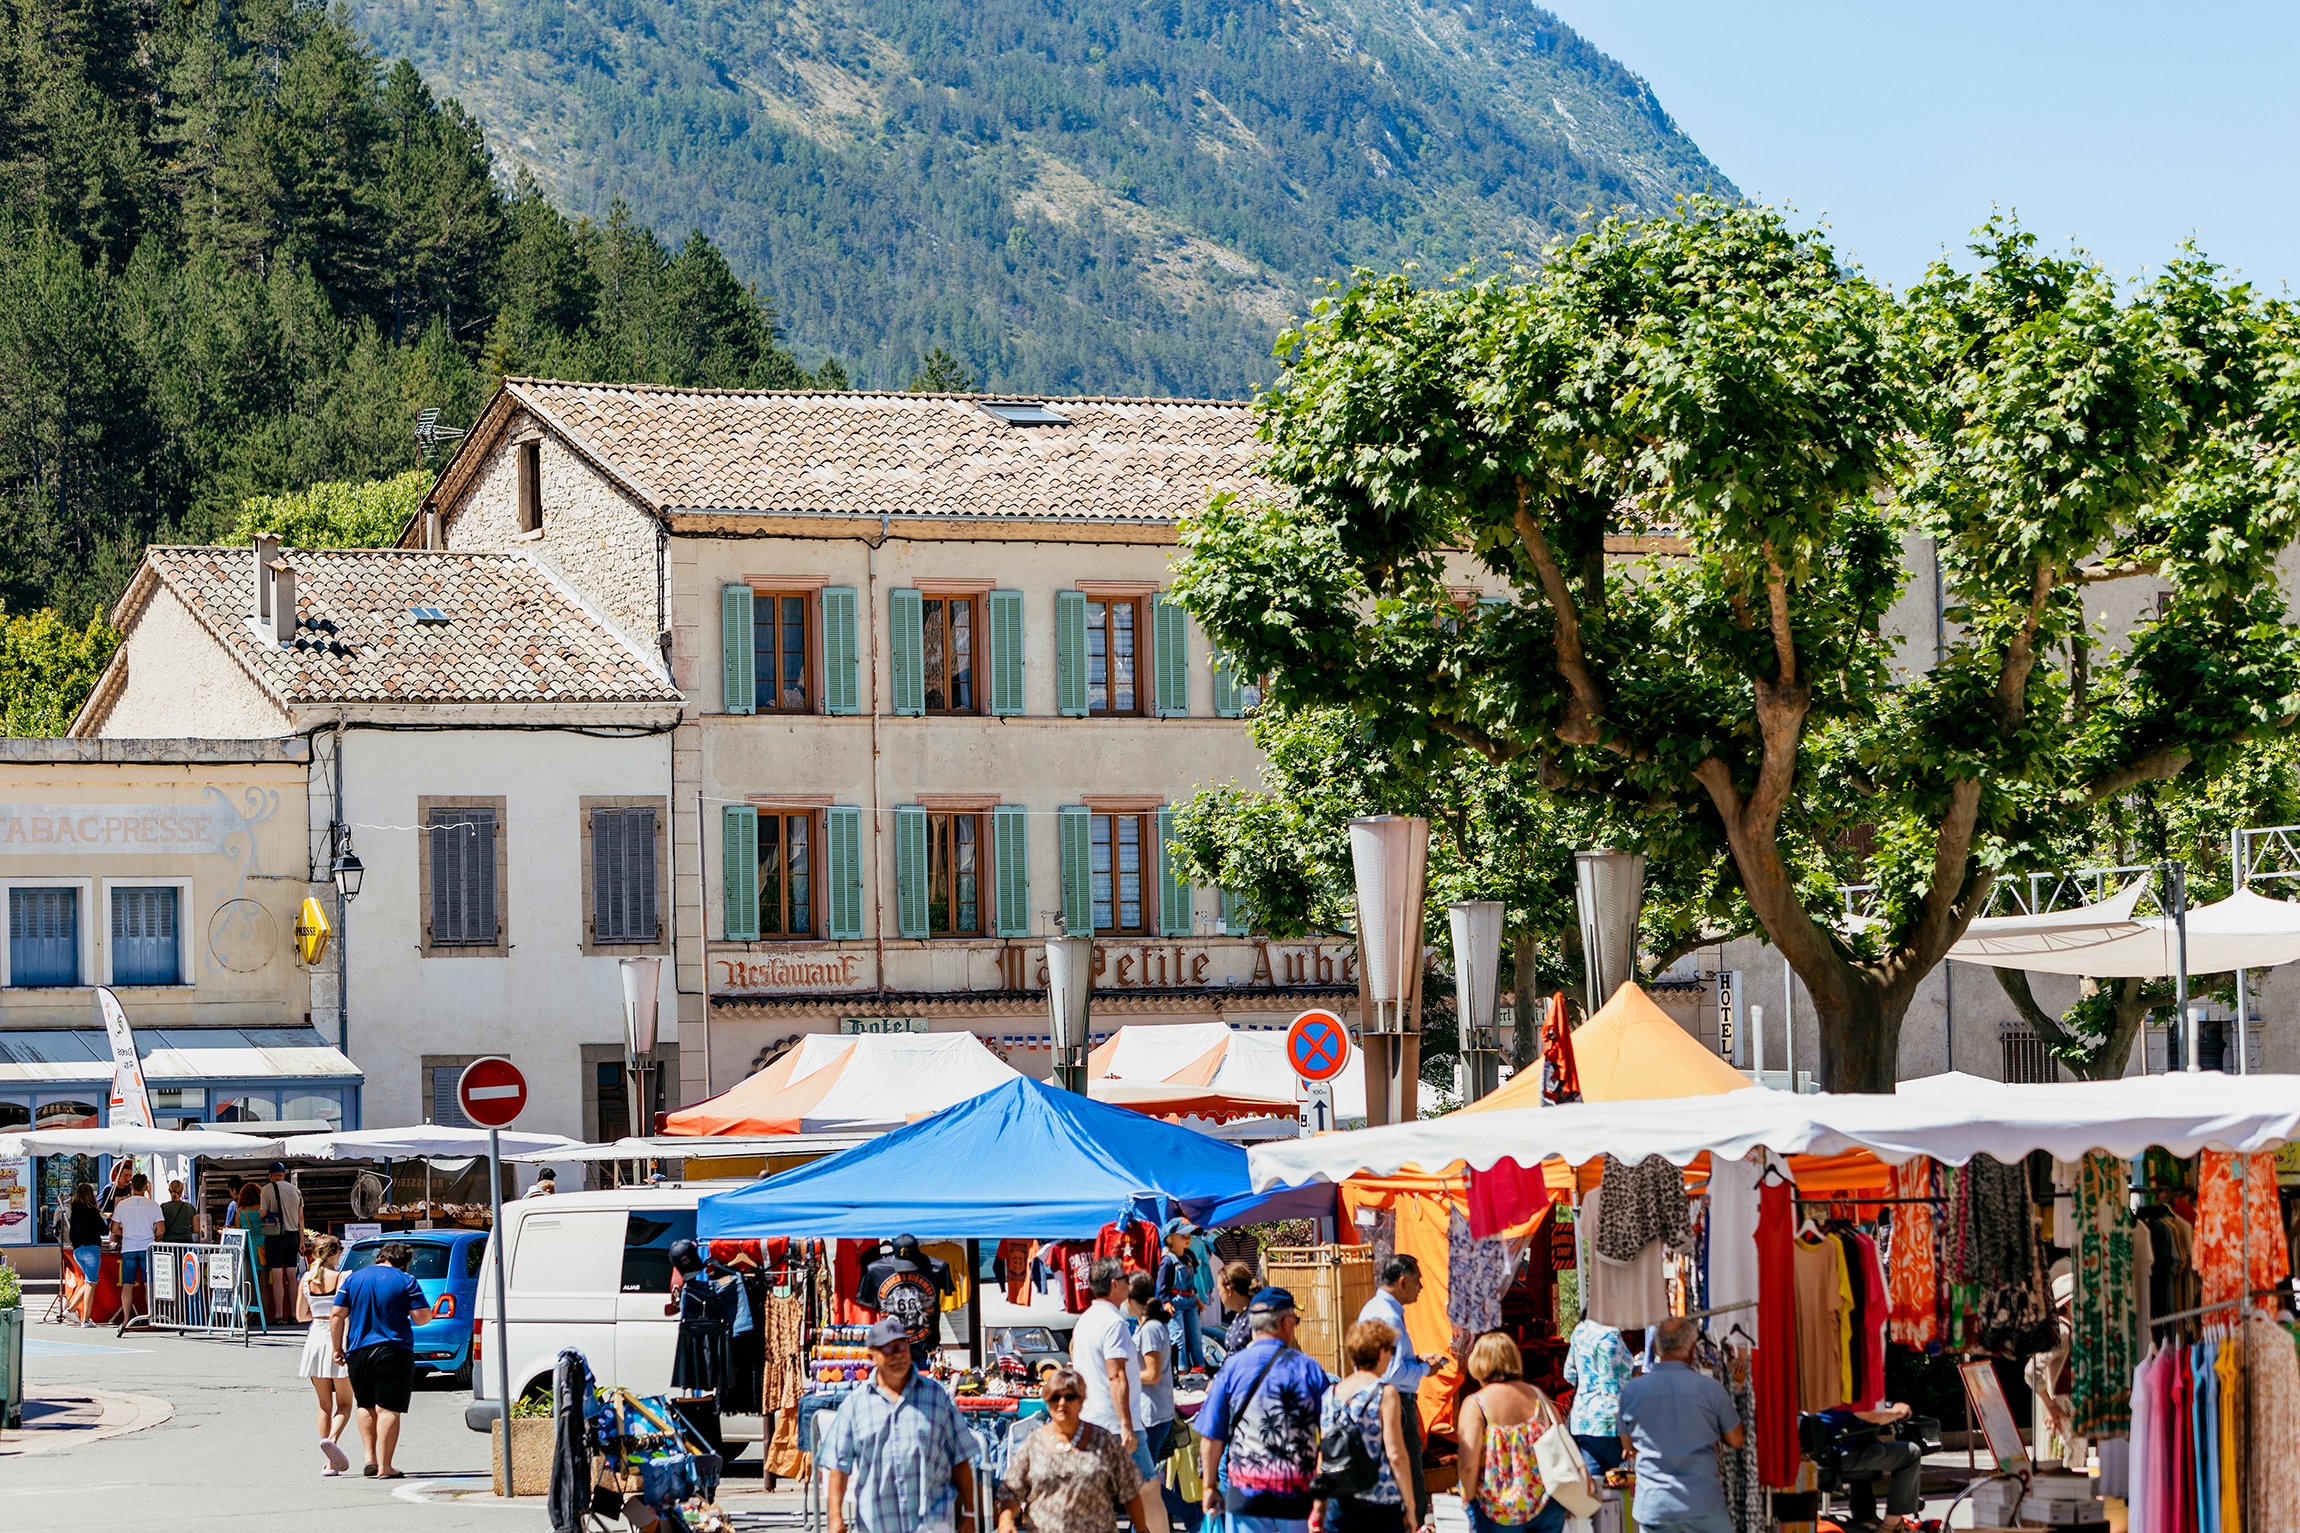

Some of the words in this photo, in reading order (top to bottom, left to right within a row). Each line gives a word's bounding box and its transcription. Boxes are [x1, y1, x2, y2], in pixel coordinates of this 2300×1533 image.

[104, 816, 212, 843] PRESSE
[296, 926, 317, 937] PRESSE
[714, 955, 865, 990] Restaurant
[1720, 974, 1733, 1055] HOTEL
[897, 1298, 917, 1313] 66
